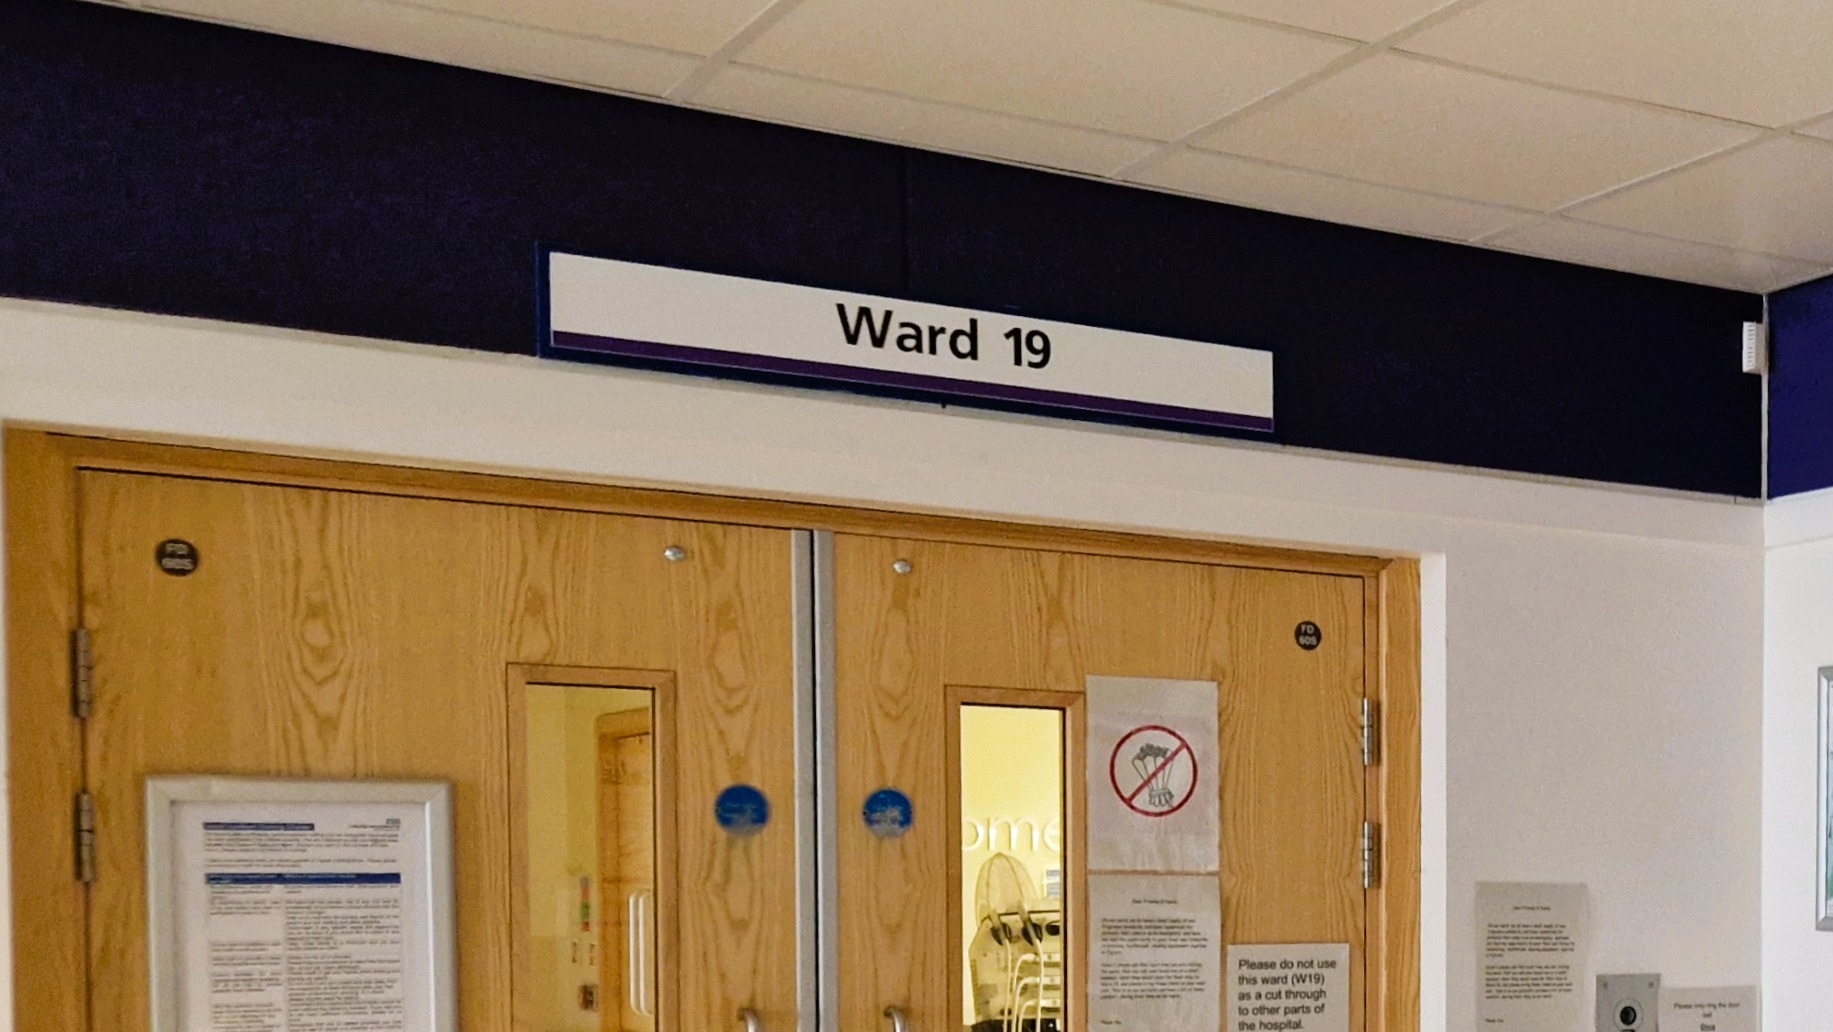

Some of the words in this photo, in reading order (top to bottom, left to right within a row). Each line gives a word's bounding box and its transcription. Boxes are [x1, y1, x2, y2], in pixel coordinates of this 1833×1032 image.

[835, 303, 979, 362] Ward
[1003, 327, 1052, 369] 19
[1238, 959, 1276, 970] Please
[1280, 959, 1294, 969] do
[1297, 959, 1314, 969] not
[1317, 960, 1337, 969] use
[1238, 974, 1258, 985] this
[1261, 974, 1288, 985] ward
[1291, 973, 1325, 986] (W19)
[1238, 991, 1251, 1000] as
[1255, 992, 1262, 1000] a
[1265, 989, 1282, 1000] cut
[1285, 988, 1326, 1001] through
[1238, 1006, 1249, 1016] to
[1252, 1005, 1280, 1016] other
[1284, 1004, 1311, 1017] parts
[1314, 1003, 1326, 1013] of
[1238, 1021, 1256, 1031] the
[1259, 1019, 1304, 1032] hospital.
